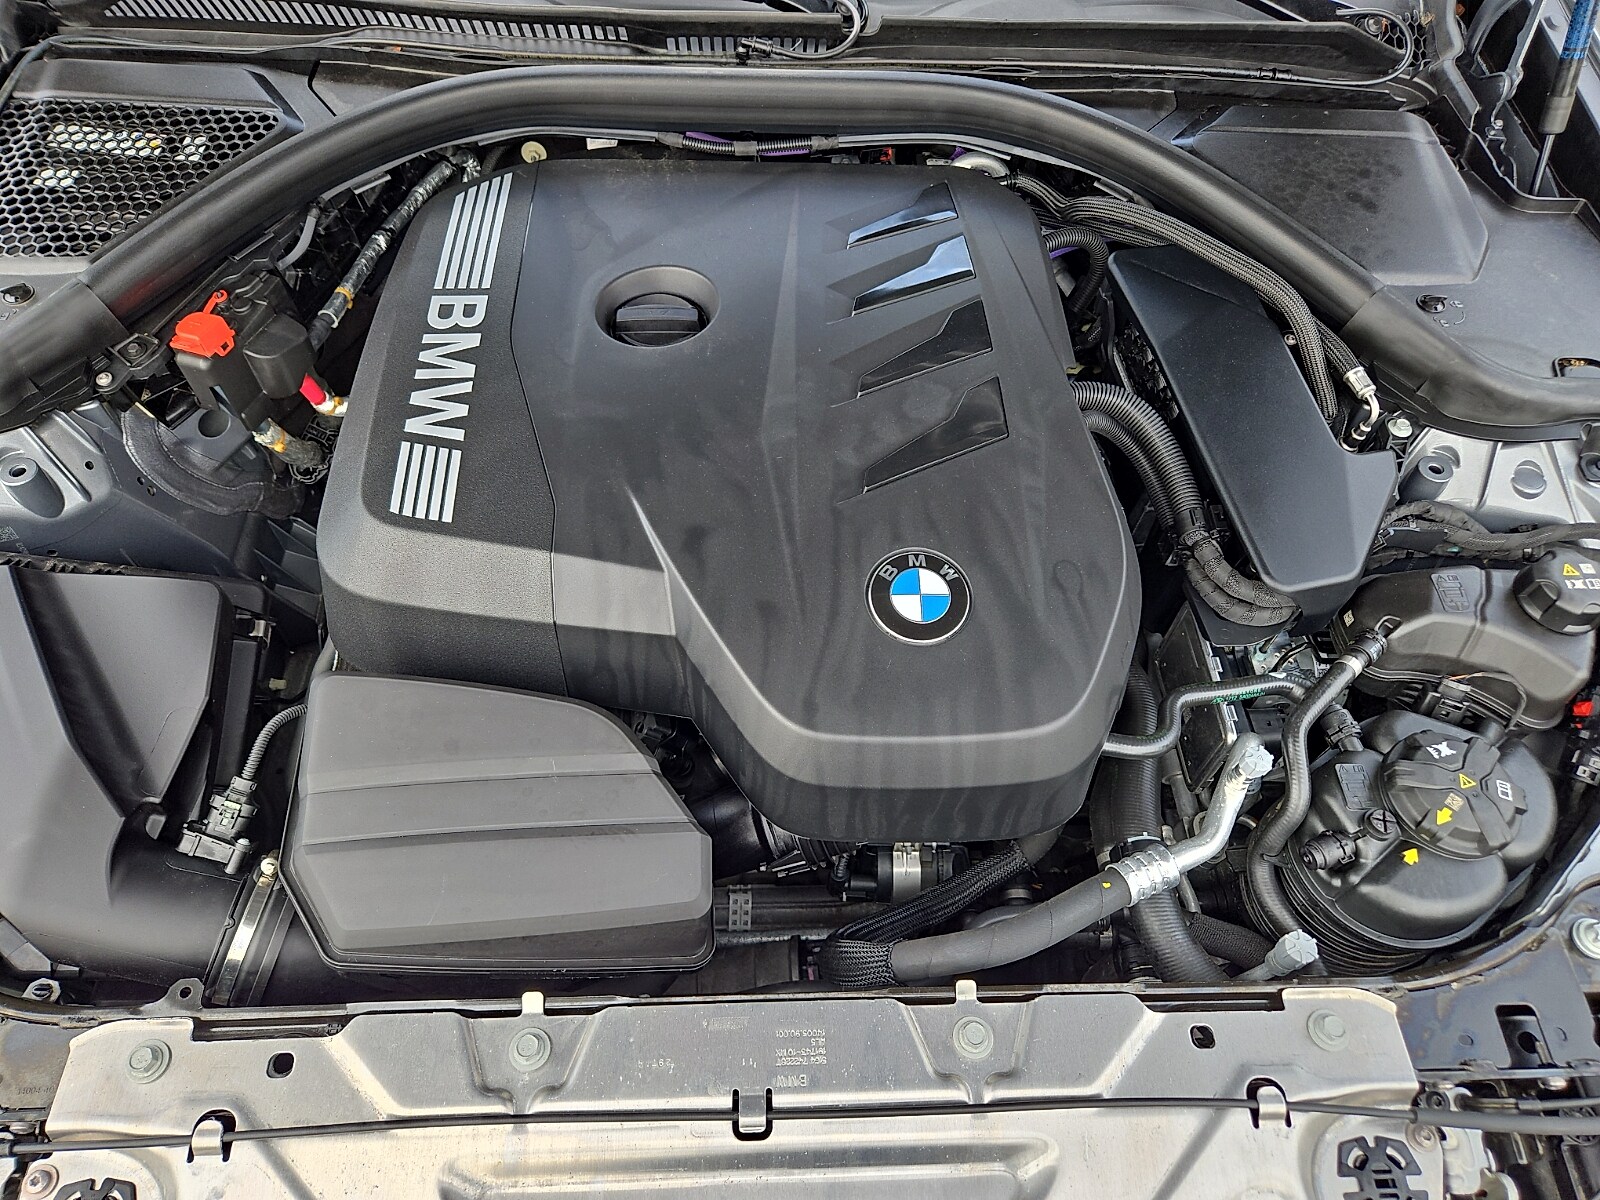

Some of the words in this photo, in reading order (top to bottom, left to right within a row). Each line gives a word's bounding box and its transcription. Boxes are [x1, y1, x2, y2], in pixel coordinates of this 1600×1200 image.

[403, 294, 489, 441] BMW
[879, 554, 959, 582] BMW
[775, 1074, 807, 1088] BMW
